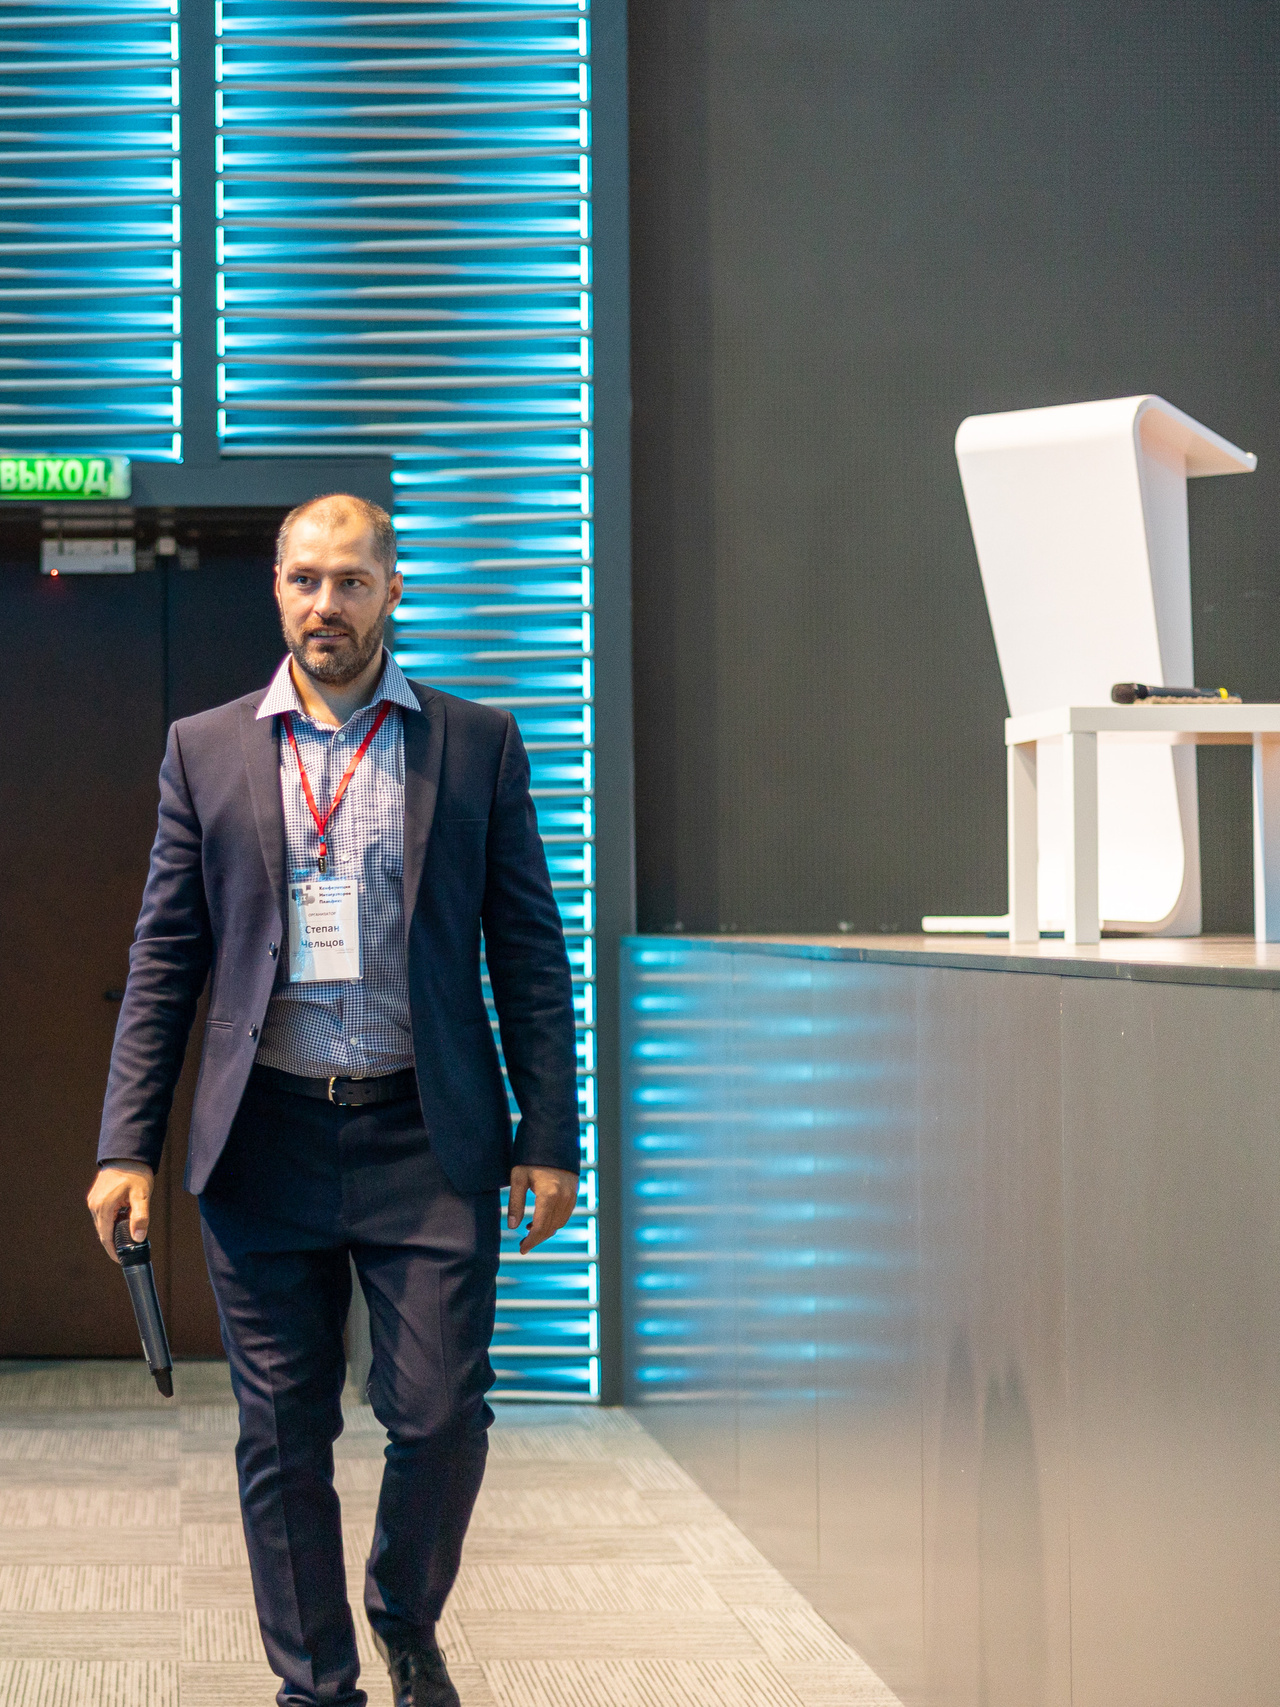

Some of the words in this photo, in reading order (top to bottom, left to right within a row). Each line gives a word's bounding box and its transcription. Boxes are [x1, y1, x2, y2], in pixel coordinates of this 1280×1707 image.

[0, 459, 107, 495] ВЫХОД
[305, 924, 340, 934] Степан
[301, 939, 345, 949] Чельцов
